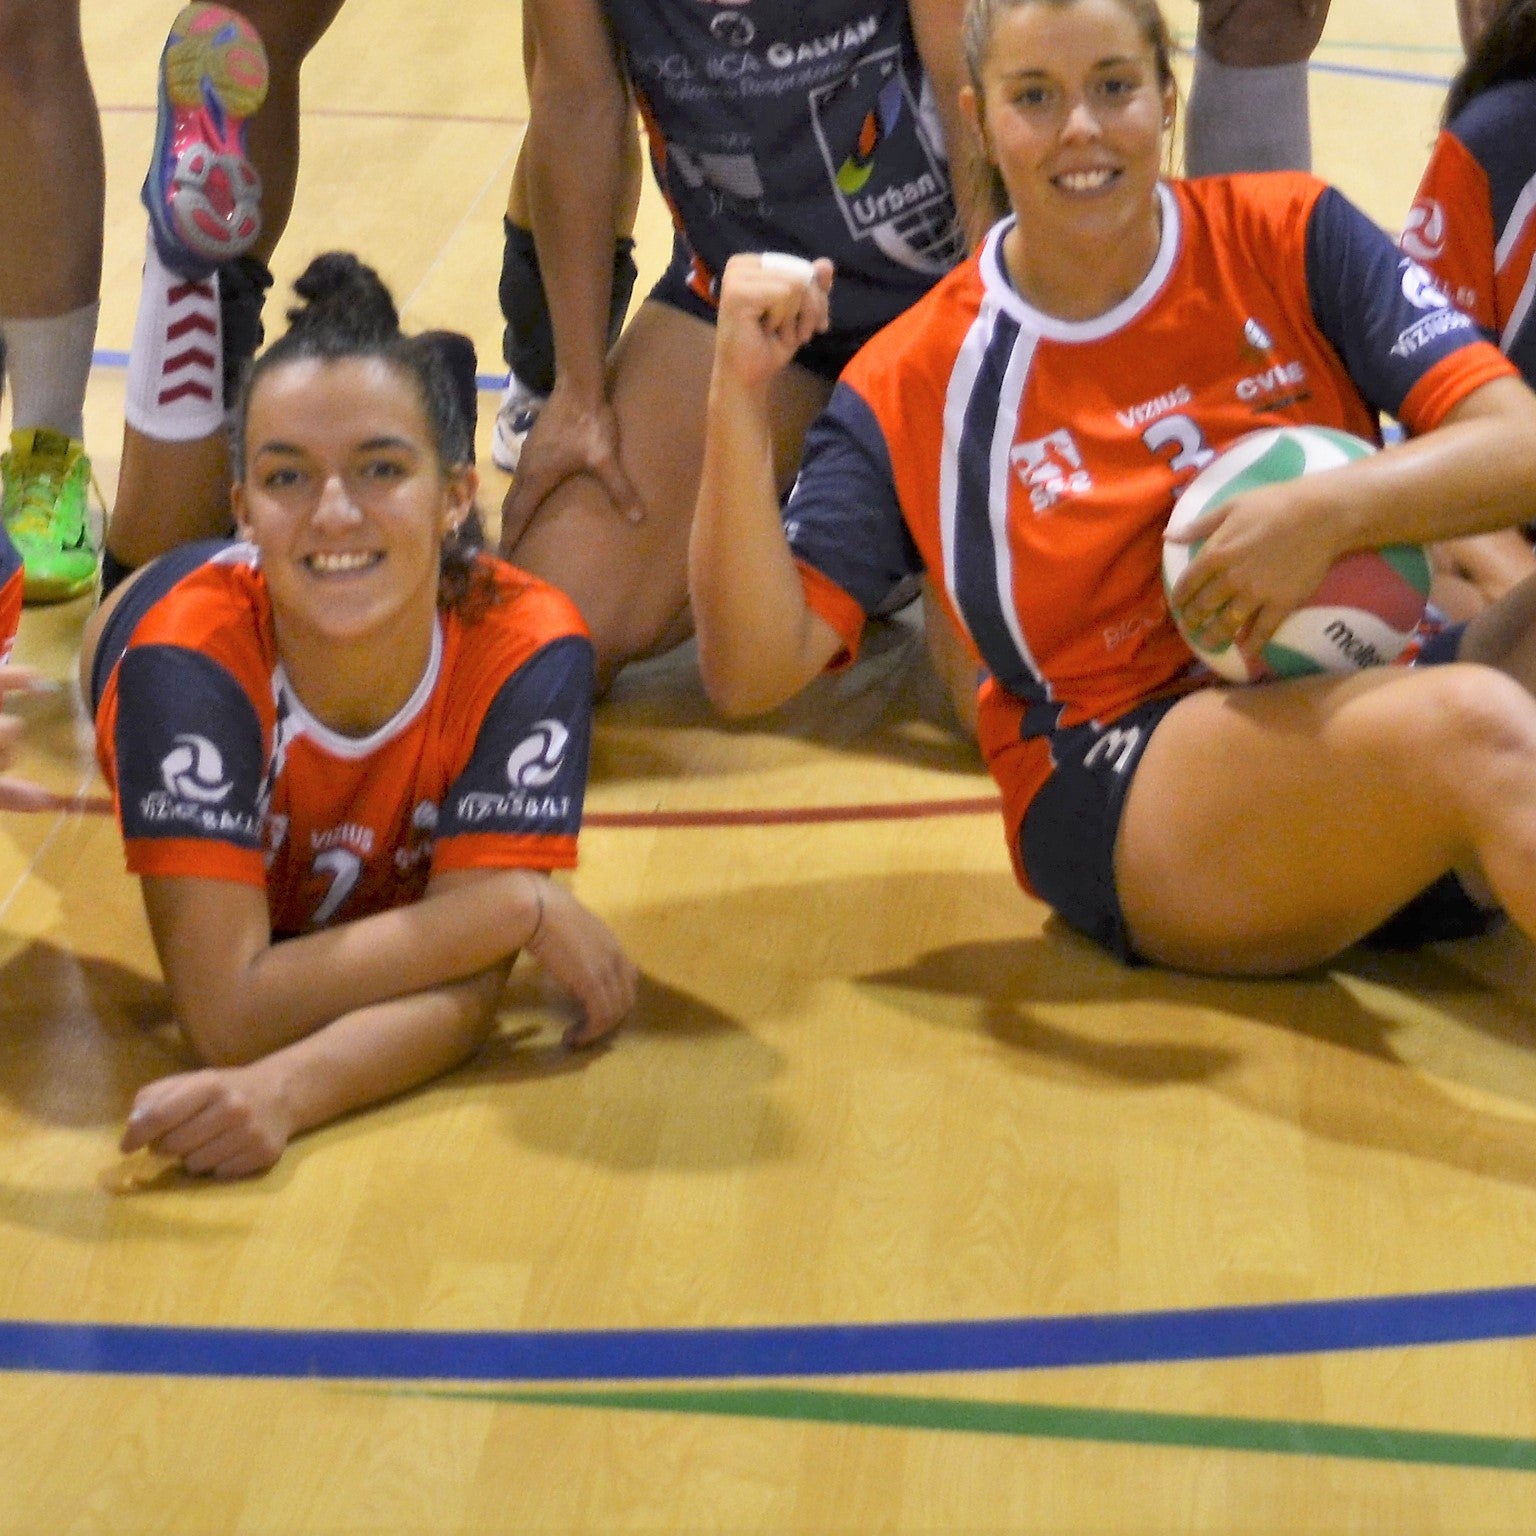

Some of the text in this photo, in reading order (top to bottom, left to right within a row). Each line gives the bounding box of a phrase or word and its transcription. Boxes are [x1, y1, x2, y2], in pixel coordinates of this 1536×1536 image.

[852, 172, 936, 225] Urban
[1324, 618, 1387, 671] molt
[312, 848, 362, 924] 7
